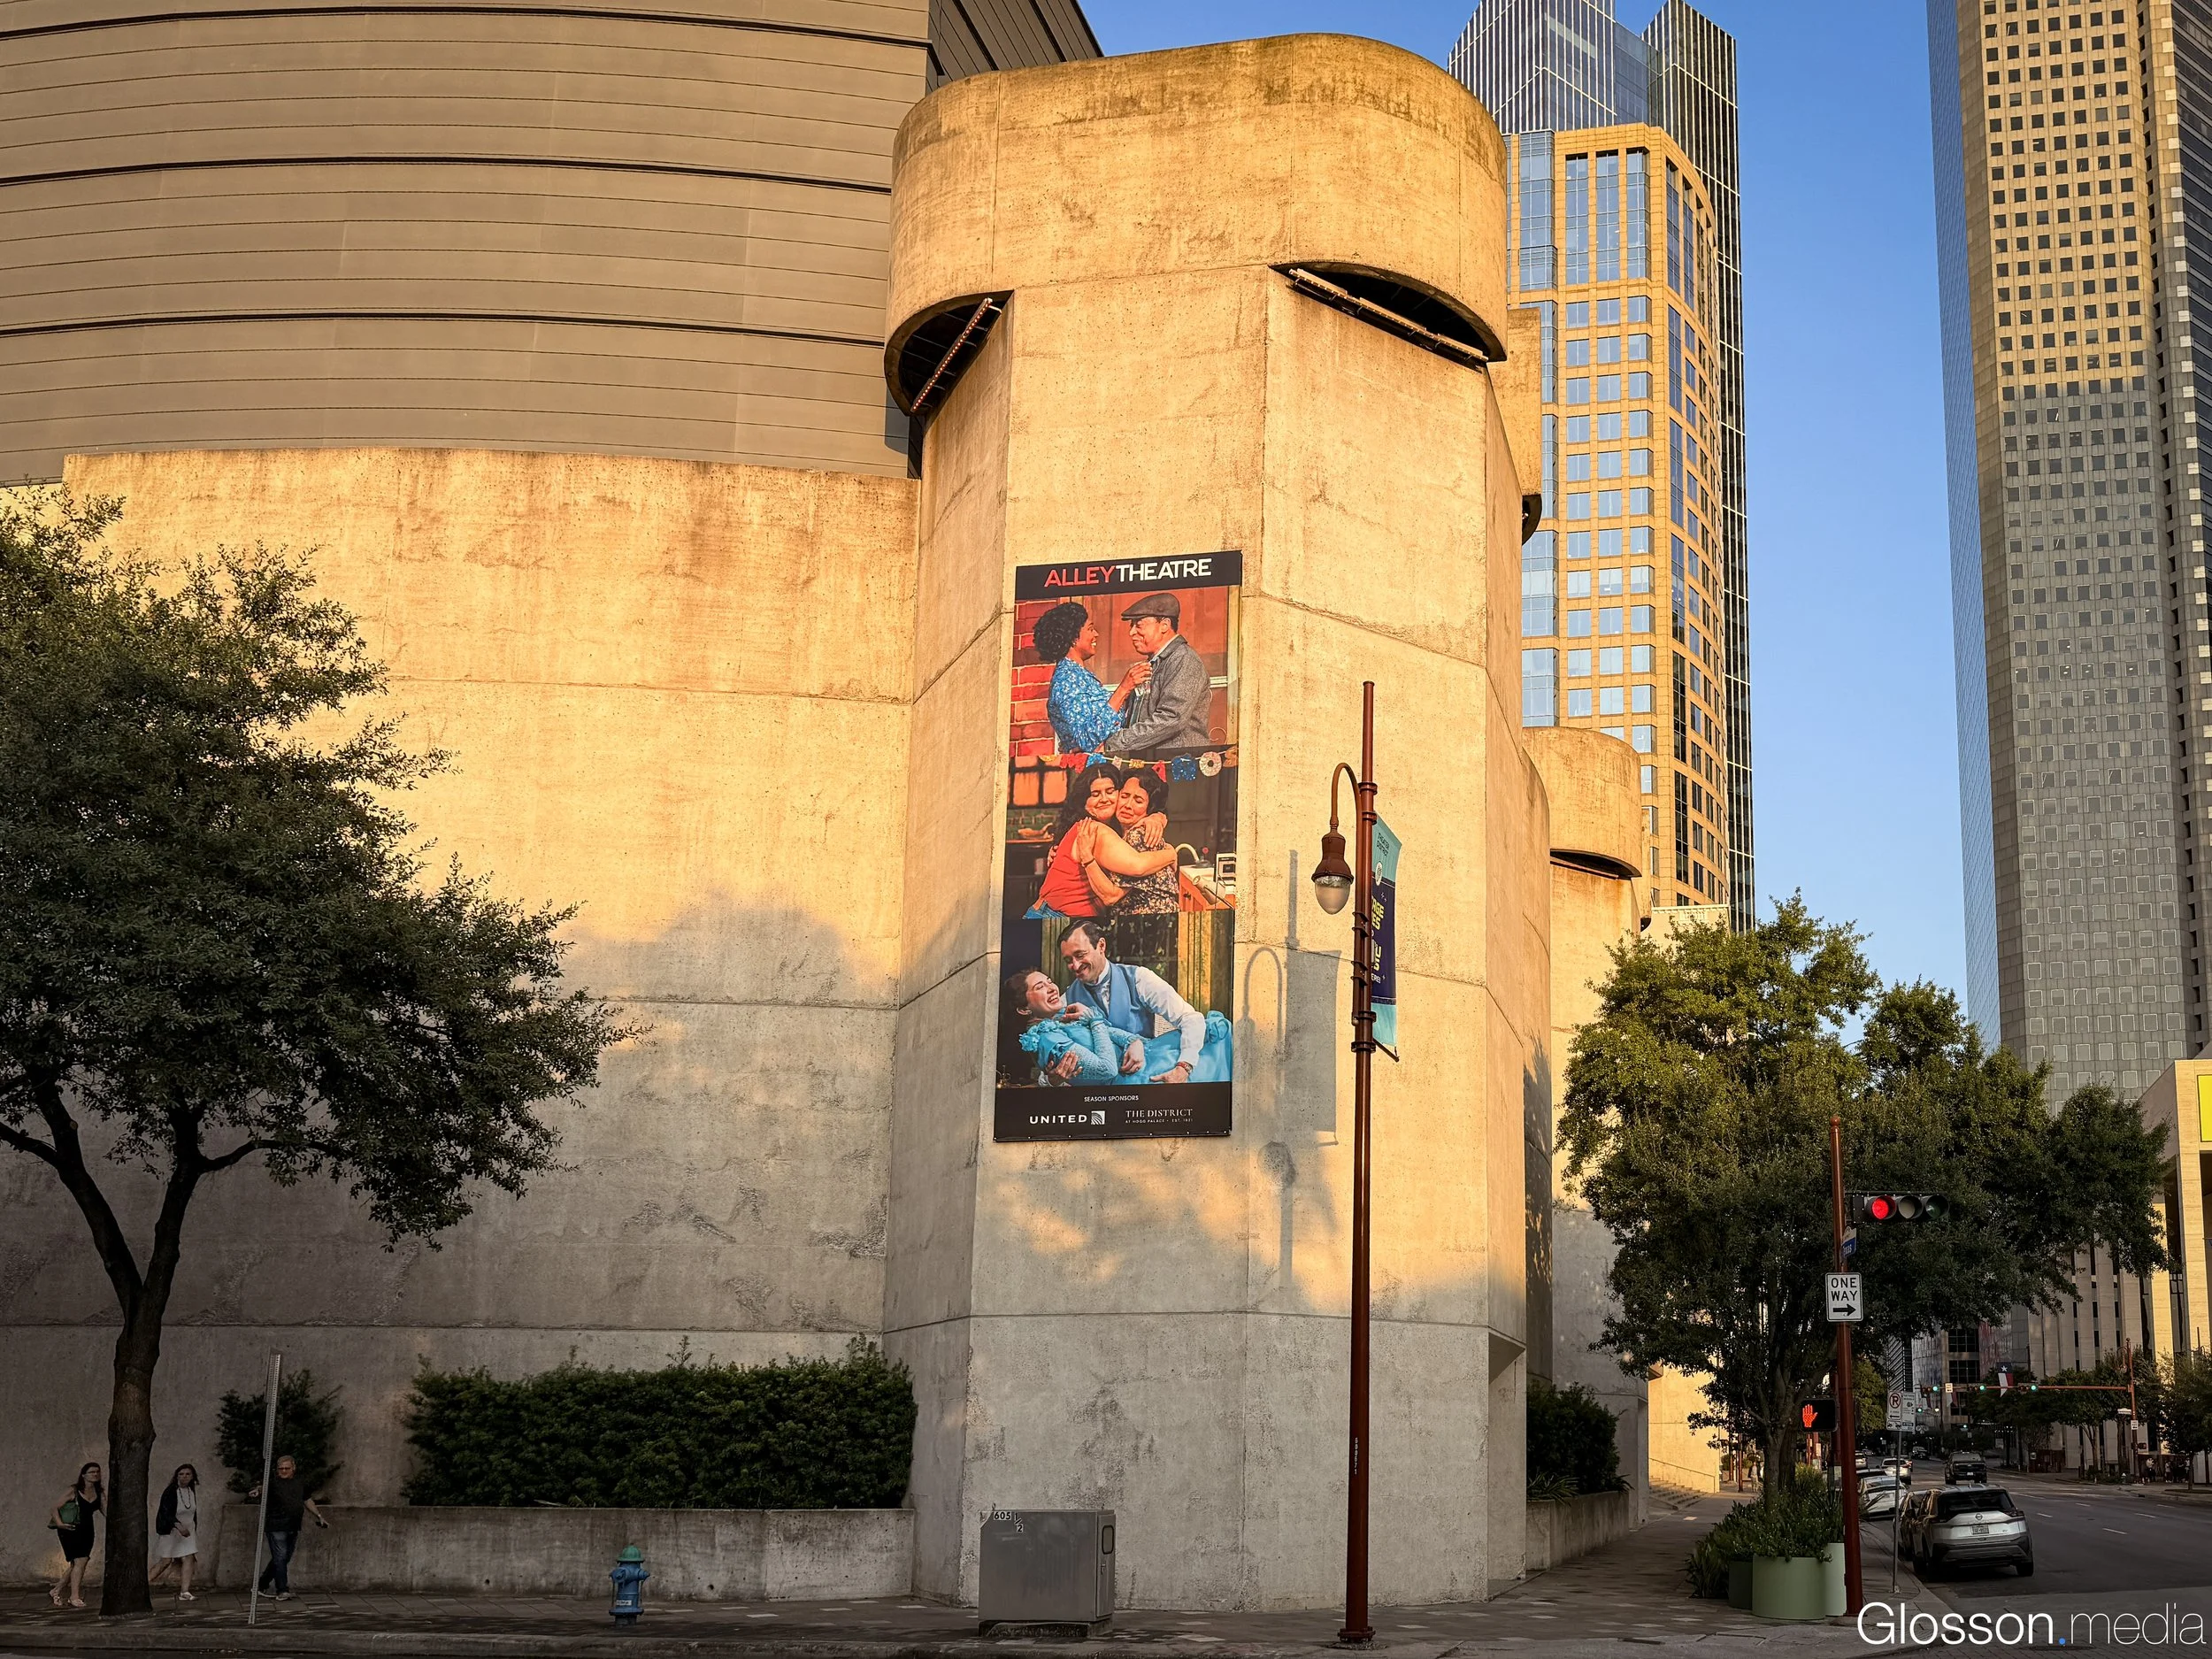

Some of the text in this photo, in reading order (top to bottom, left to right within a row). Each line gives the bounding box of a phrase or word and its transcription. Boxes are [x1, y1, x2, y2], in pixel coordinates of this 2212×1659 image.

[1125, 1109, 1194, 1118] THE DISTRICT
[1029, 1115, 1087, 1125] UNITED
[1831, 1277, 1857, 1288] ONE
[1831, 1290, 1858, 1302] WAY
